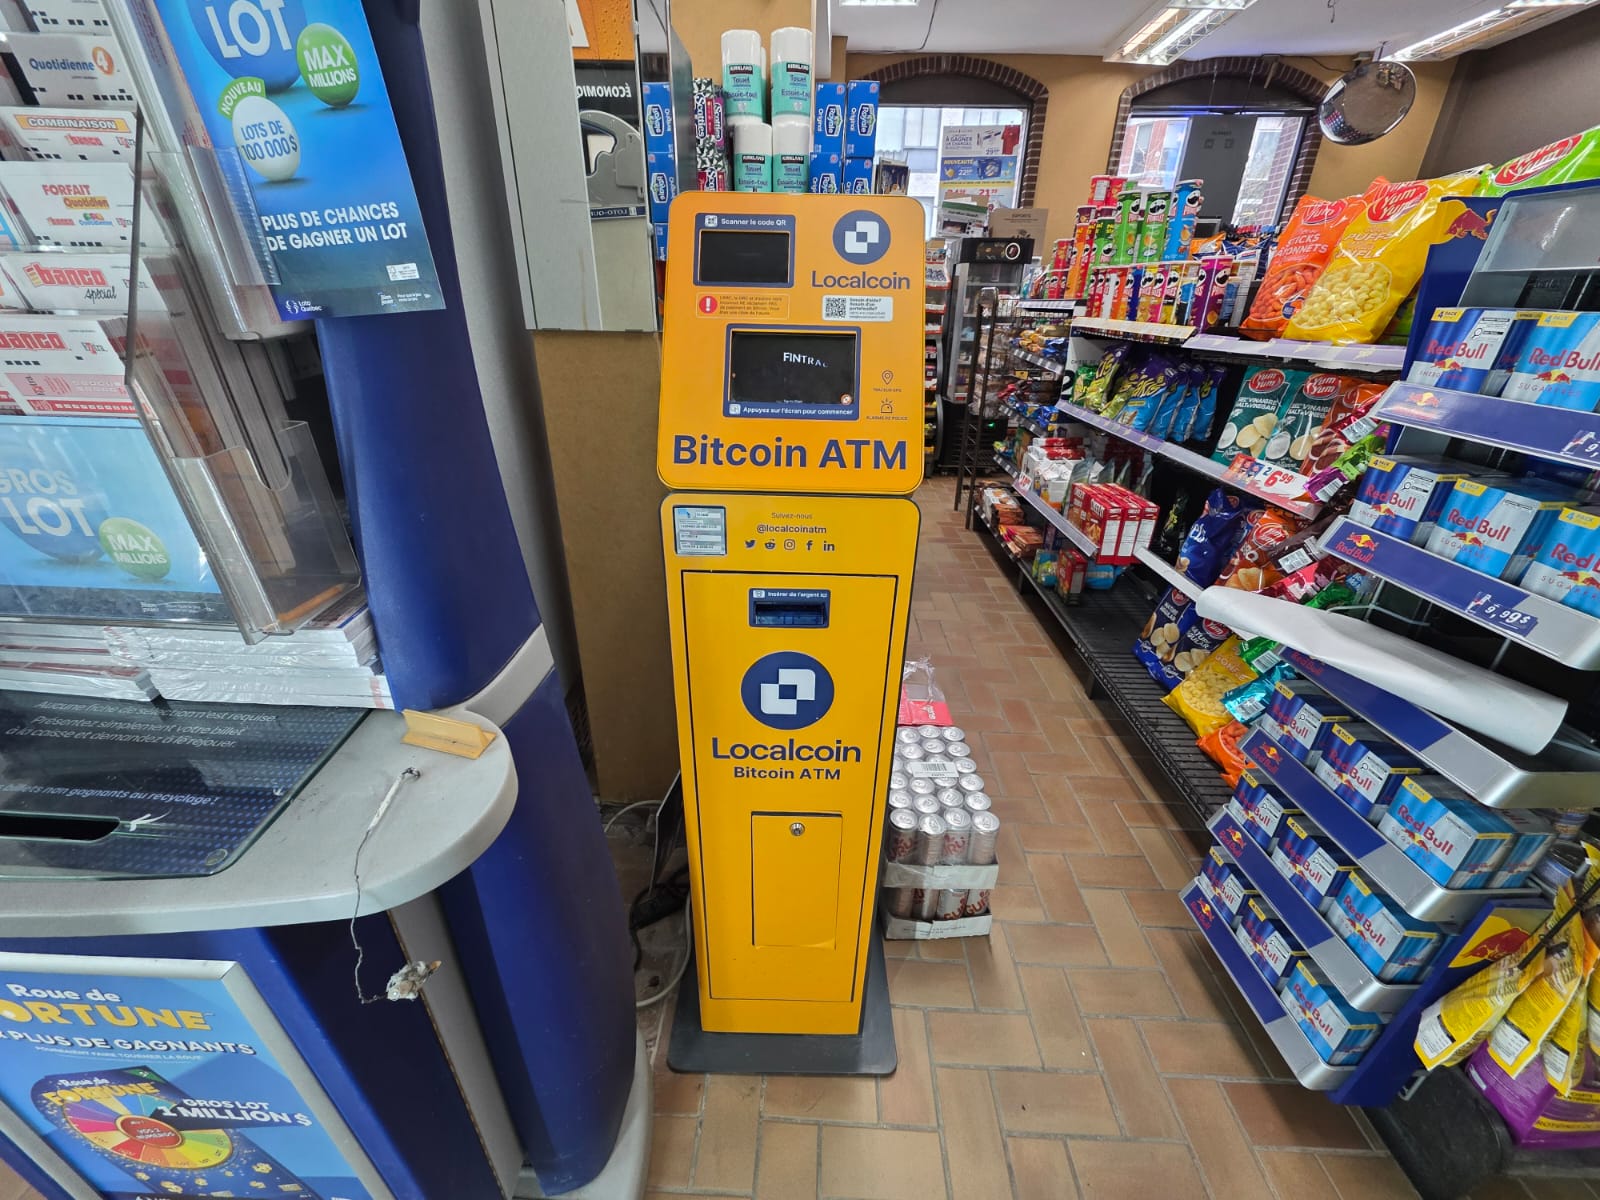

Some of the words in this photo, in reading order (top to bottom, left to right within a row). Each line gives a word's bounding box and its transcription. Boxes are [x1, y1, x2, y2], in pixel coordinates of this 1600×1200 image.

[205, 0, 294, 58] LOT
[29, 57, 95, 72] Quotidienne
[303, 44, 350, 72] MAX
[307, 67, 357, 88] MILLIONS
[220, 80, 262, 116] NOUVEAU
[28, 117, 117, 129] COMBINAISON
[696, 93, 705, 138] Scotties
[827, 106, 836, 134] Royale
[860, 106, 869, 133] Royale
[240, 122, 267, 141] LOTS
[269, 120, 284, 136] DE
[242, 142, 268, 161] 100
[42, 184, 91, 196] FORFAIT
[1383, 187, 1416, 207] Yum
[261, 214, 297, 232] PLUS
[301, 211, 323, 227] DE
[326, 202, 399, 225] CHANCES
[721, 217, 749, 225] Scanner
[749, 218, 757, 226] le
[757, 218, 775, 226] code
[266, 235, 288, 252] DE
[288, 228, 354, 250] GAGNER
[356, 226, 378, 242] UN
[380, 223, 408, 240] LOT
[1287, 233, 1321, 247] STICKS
[811, 271, 911, 290] Localcoin
[1427, 339, 1457, 356] Red
[1455, 342, 1488, 359] Bull
[1528, 348, 1566, 368] Red
[1564, 351, 1600, 371] Bull
[1256, 381, 1276, 389] Yum
[1311, 385, 1335, 395] Yum
[743, 406, 769, 414] Appuyez
[781, 406, 801, 414] l'écran
[673, 434, 807, 468] Bitcoin
[818, 439, 907, 470] ATM
[1364, 483, 1389, 502] Red
[1389, 492, 1416, 511] Bull
[5, 497, 95, 537] LOT
[1447, 508, 1479, 530] Red
[1476, 519, 1511, 542] Bull
[756, 524, 827, 534] @localcoinatm
[106, 534, 156, 552] MAX
[1335, 541, 1353, 557] Red
[1351, 547, 1374, 564] Bull
[114, 551, 167, 565] MILLIONS
[1551, 543, 1595, 569] Red
[31, 715, 94, 727] Présentez
[97, 719, 175, 732] simplement
[176, 723, 210, 734] votre
[210, 725, 246, 736] billet
[1272, 704, 1290, 723] Red
[1289, 719, 1309, 738] Bull
[89, 731, 159, 743] demandez
[711, 736, 861, 763] Localcoin
[733, 766, 795, 779] Bitcoin
[799, 767, 841, 780] ATM
[1328, 749, 1350, 770] Red
[1349, 767, 1372, 791] Bull
[46, 786, 70, 794] non
[70, 787, 127, 800] gagnants
[129, 791, 148, 800] au
[1238, 790, 1255, 812] Red
[1253, 806, 1271, 827] Bull
[1397, 804, 1425, 832] Red
[1423, 826, 1454, 856] Bull
[1284, 841, 1304, 865] Red
[1302, 860, 1323, 884] Bull
[1220, 882, 1235, 905] Bull
[1343, 894, 1364, 922] Red
[1362, 918, 1387, 948] Bull
[1246, 920, 1264, 942] Red
[1262, 938, 1279, 965] Bull
[6, 982, 90, 1001] Roue
[92, 988, 122, 1003] de
[1293, 983, 1313, 1010] Red
[1311, 1008, 1334, 1038] Bull
[7, 1031, 72, 1047] PLUS
[73, 1036, 111, 1050] DE
[114, 1038, 256, 1056] GAGNANTS
[42, 1082, 160, 1106] FORTUNE
[183, 1098, 231, 1109] GROS
[233, 1100, 269, 1111] LOT
[158, 1104, 178, 1117] 1
[180, 1106, 290, 1124] MILLION
[292, 1113, 313, 1127] $
